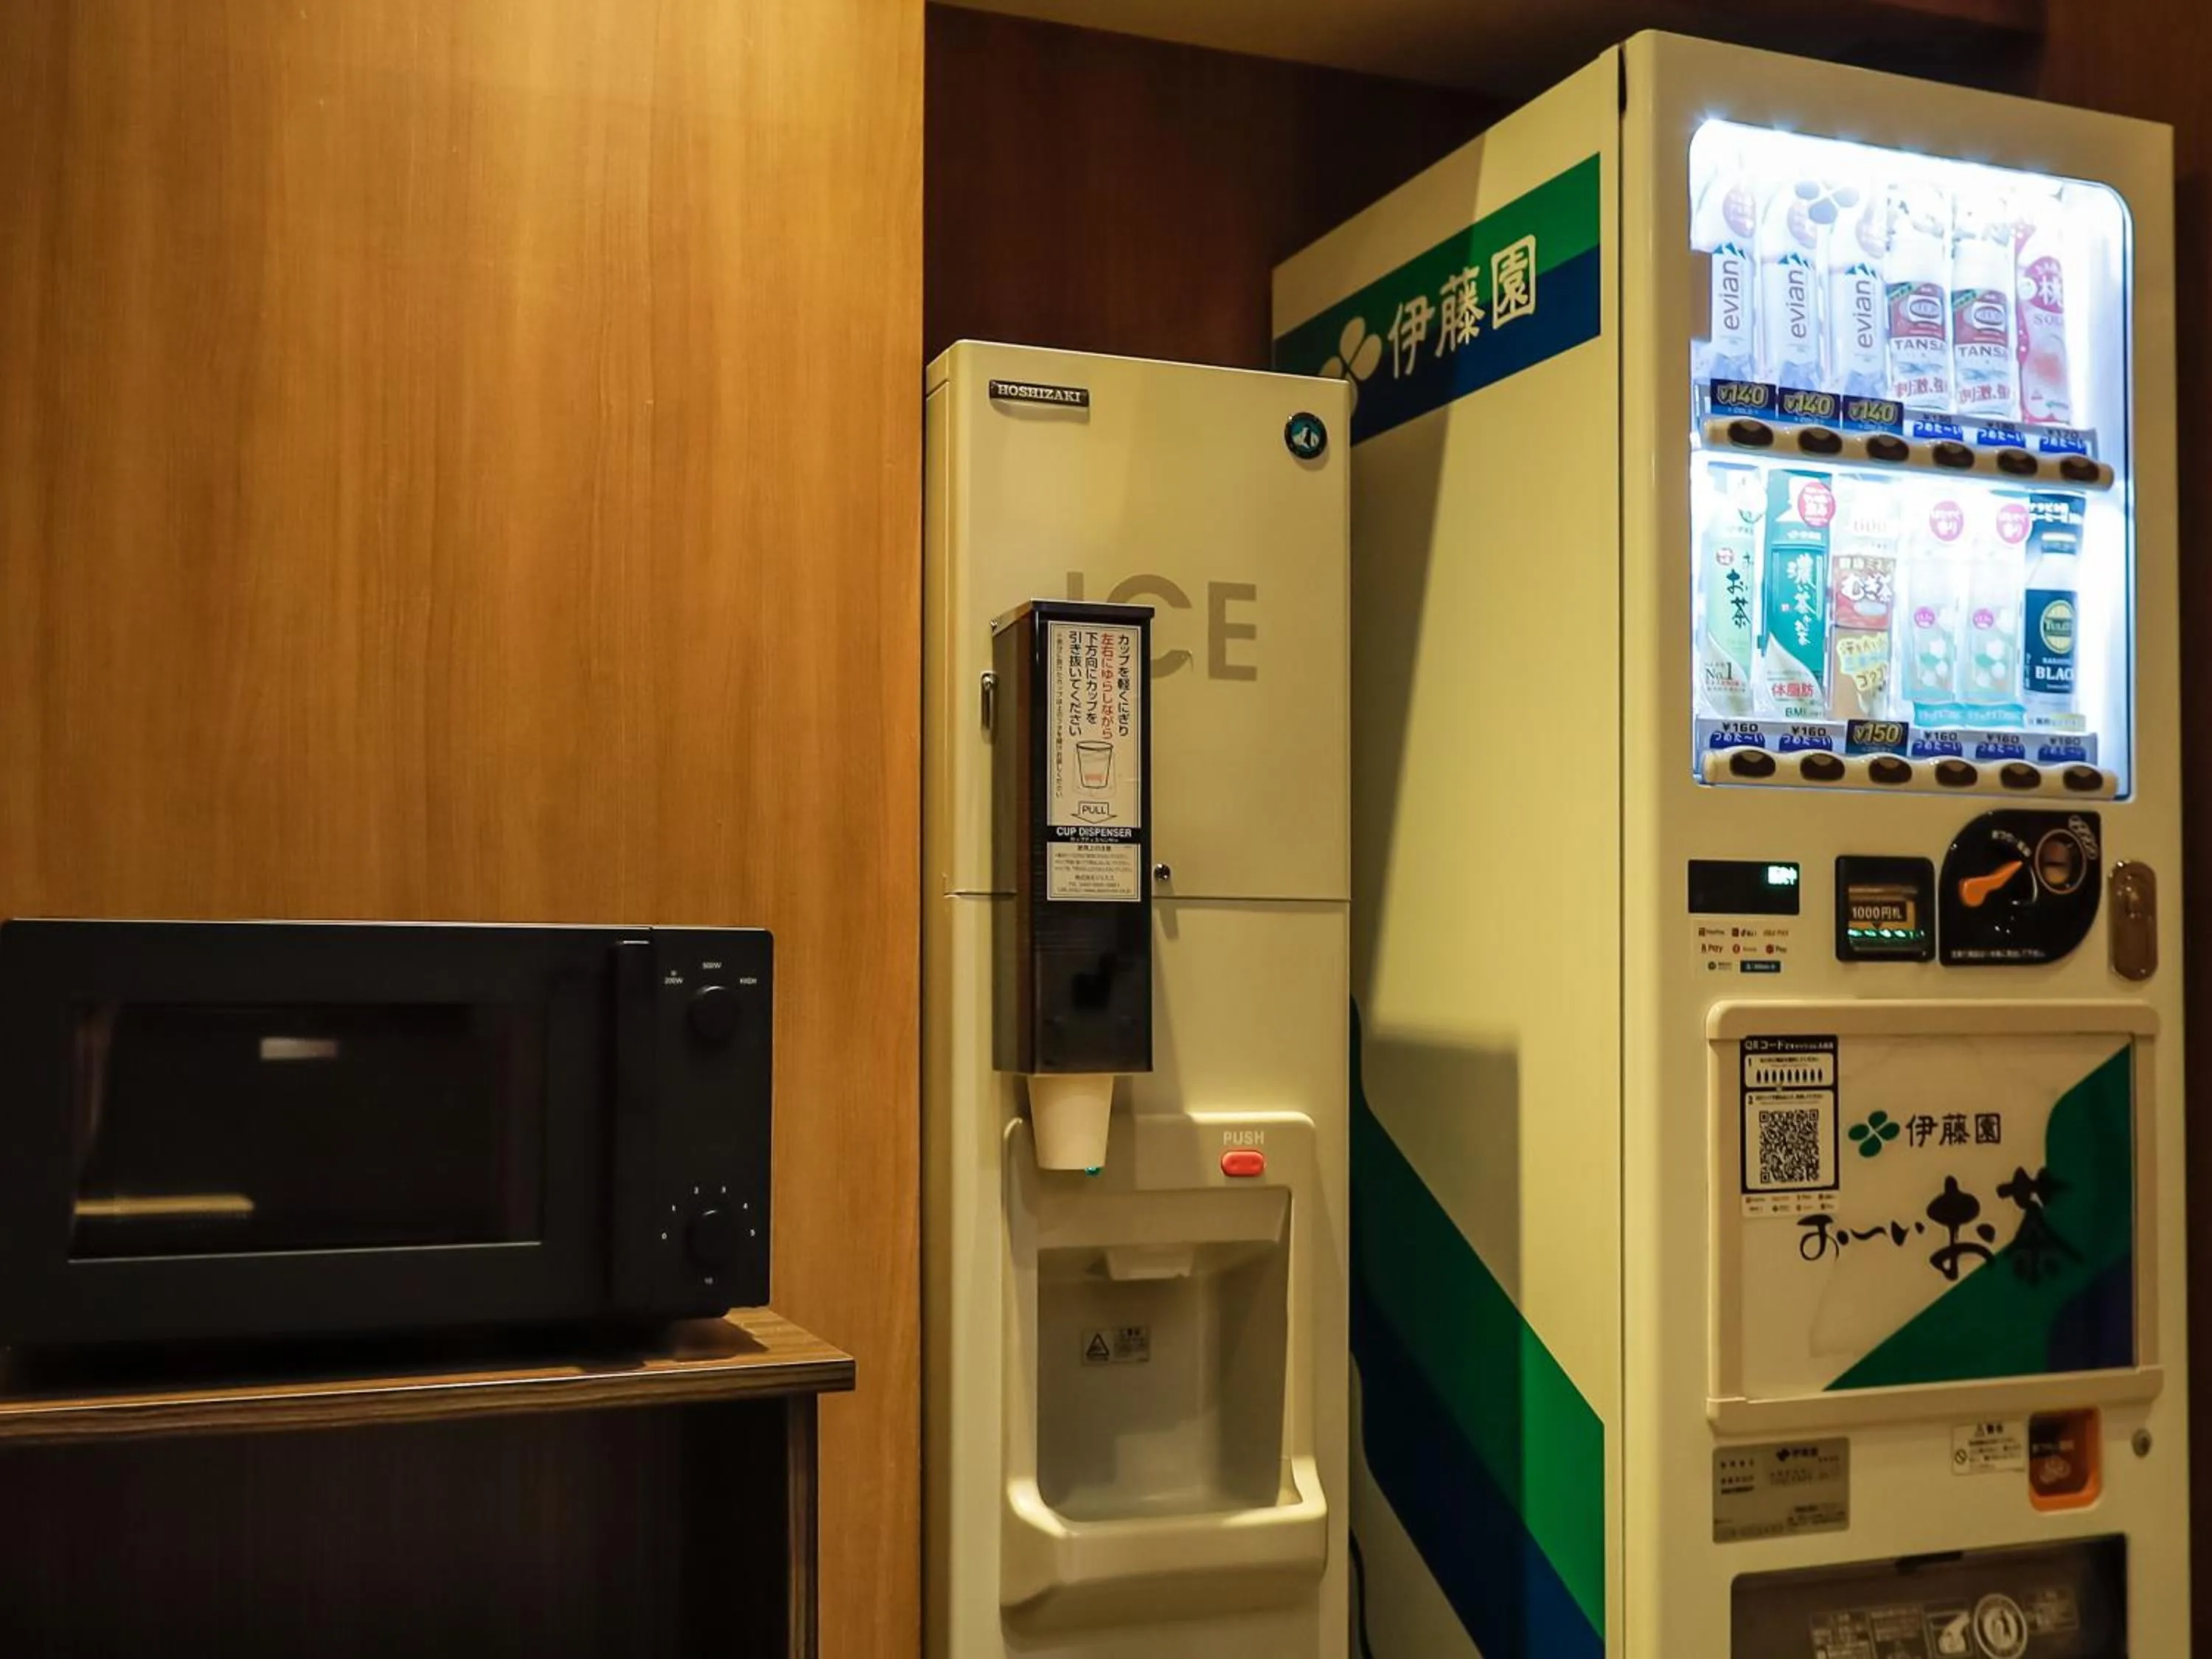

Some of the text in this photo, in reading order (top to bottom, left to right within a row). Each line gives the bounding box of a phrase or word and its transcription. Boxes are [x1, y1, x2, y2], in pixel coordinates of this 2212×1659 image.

[1388, 234, 1536, 380] 伊藤園
[1719, 260, 1739, 330] evian
[1786, 269, 1806, 338] evian
[1853, 279, 1873, 348] evian
[1958, 347, 2008, 358] TANS
[998, 384, 1081, 402] HOSHIZAKI
[1719, 383, 1767, 405] ¥140
[1785, 394, 1833, 414] ¥140
[1850, 402, 1897, 422] ¥140
[1067, 571, 1256, 681] CE
[1069, 631, 1082, 737] 引き抜いてください
[1085, 632, 1099, 725] 下方向にカップを
[1101, 633, 1114, 739] 左右にゆらしながら
[1117, 633, 1130, 737] カップを軽くにぎり
[2035, 666, 2073, 681] BLAC
[1854, 721, 1902, 744] ¥150
[1082, 804, 1106, 815] PULL
[1056, 827, 1133, 838] CUP DISPENSER
[1223, 1131, 1265, 1145] PUSH
[1905, 1113, 2002, 1147] 伊藤園
